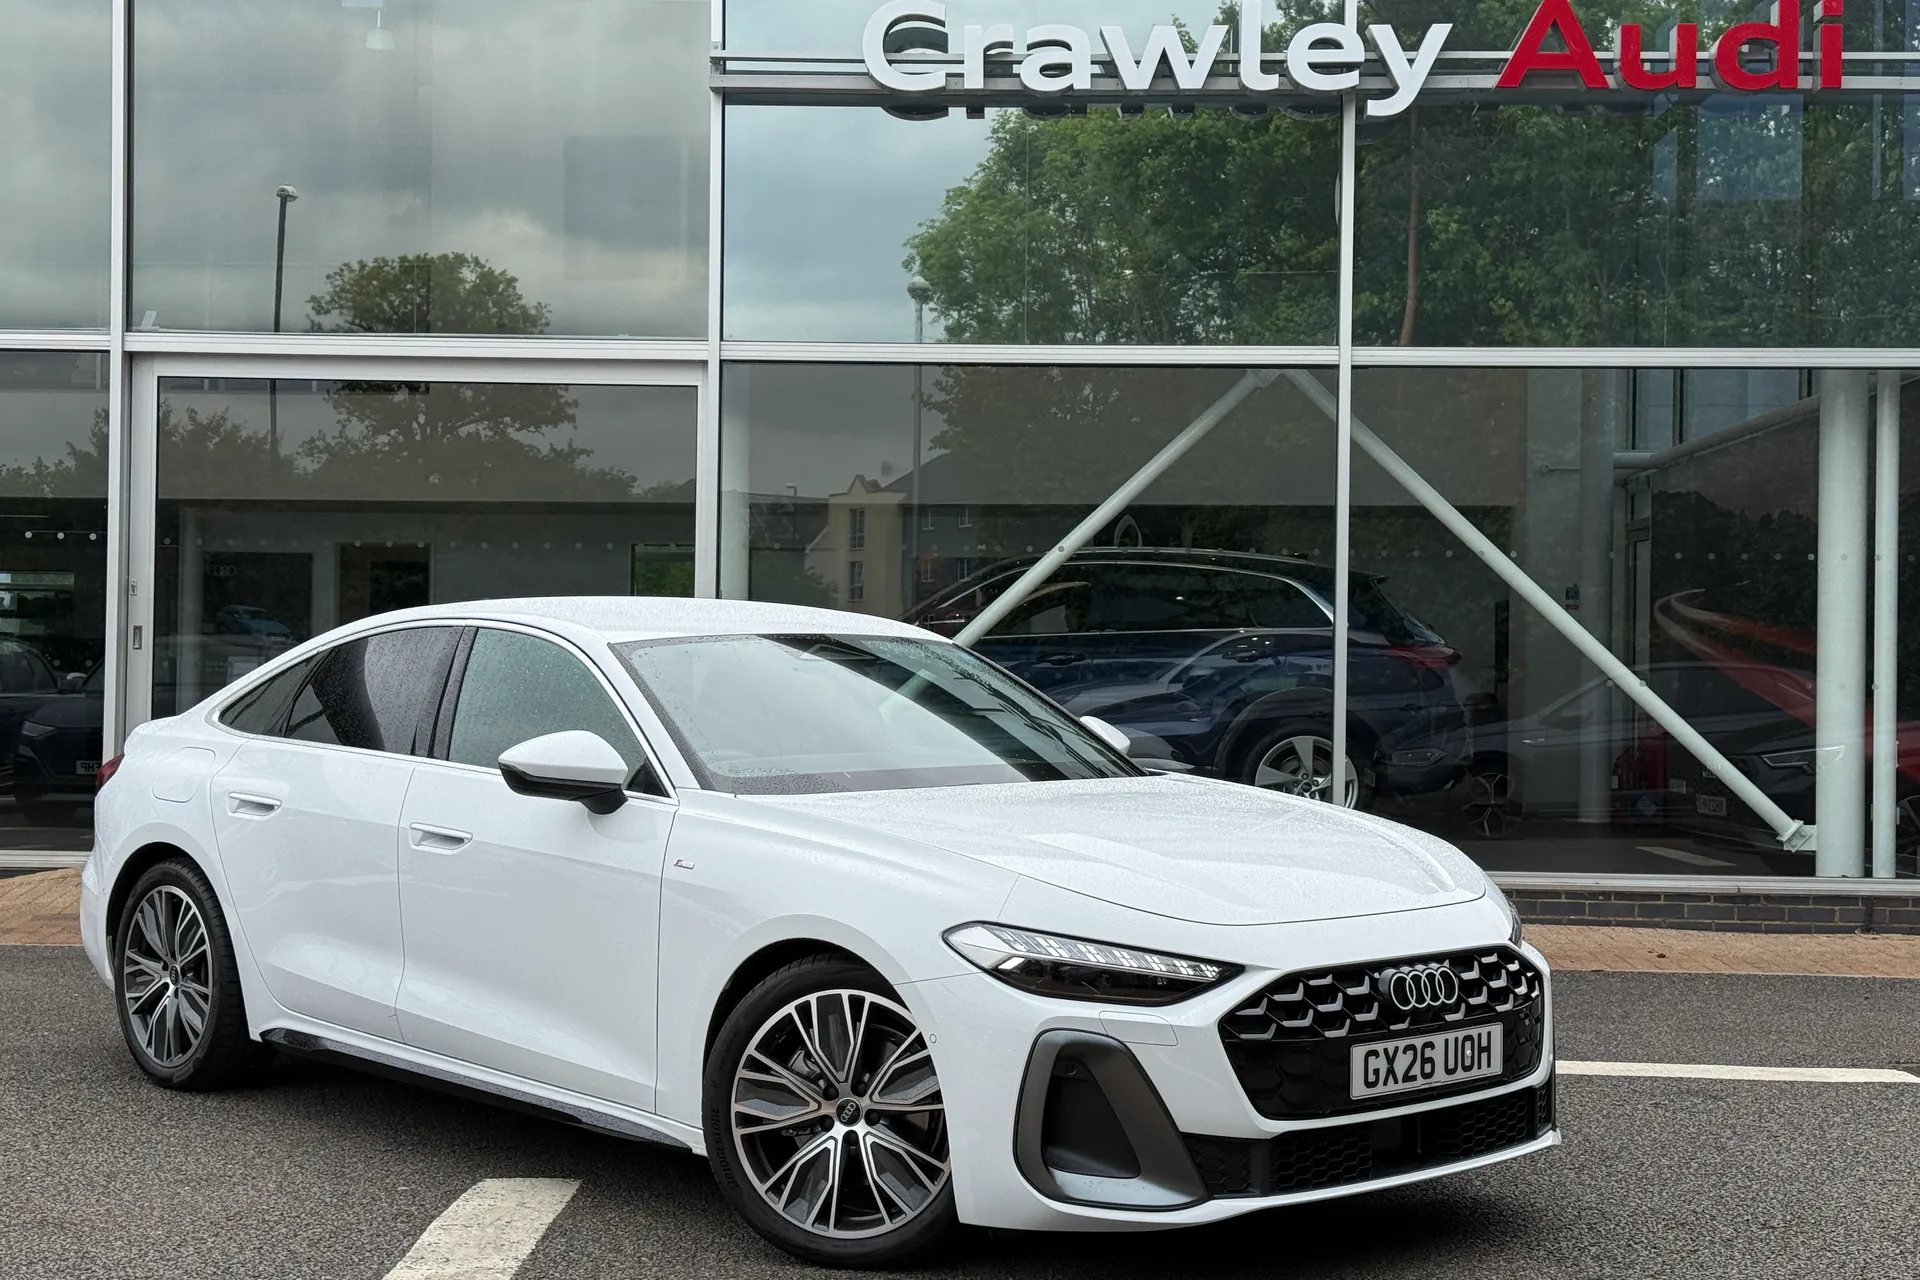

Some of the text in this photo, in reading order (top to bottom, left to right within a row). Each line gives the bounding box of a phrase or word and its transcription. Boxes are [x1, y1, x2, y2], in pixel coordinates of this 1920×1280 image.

[862, 0, 1844, 117] Crawley Audi
[1363, 1031, 1492, 1089] GX26 UOH
[711, 1106, 740, 1190] BRIDGESTONE
